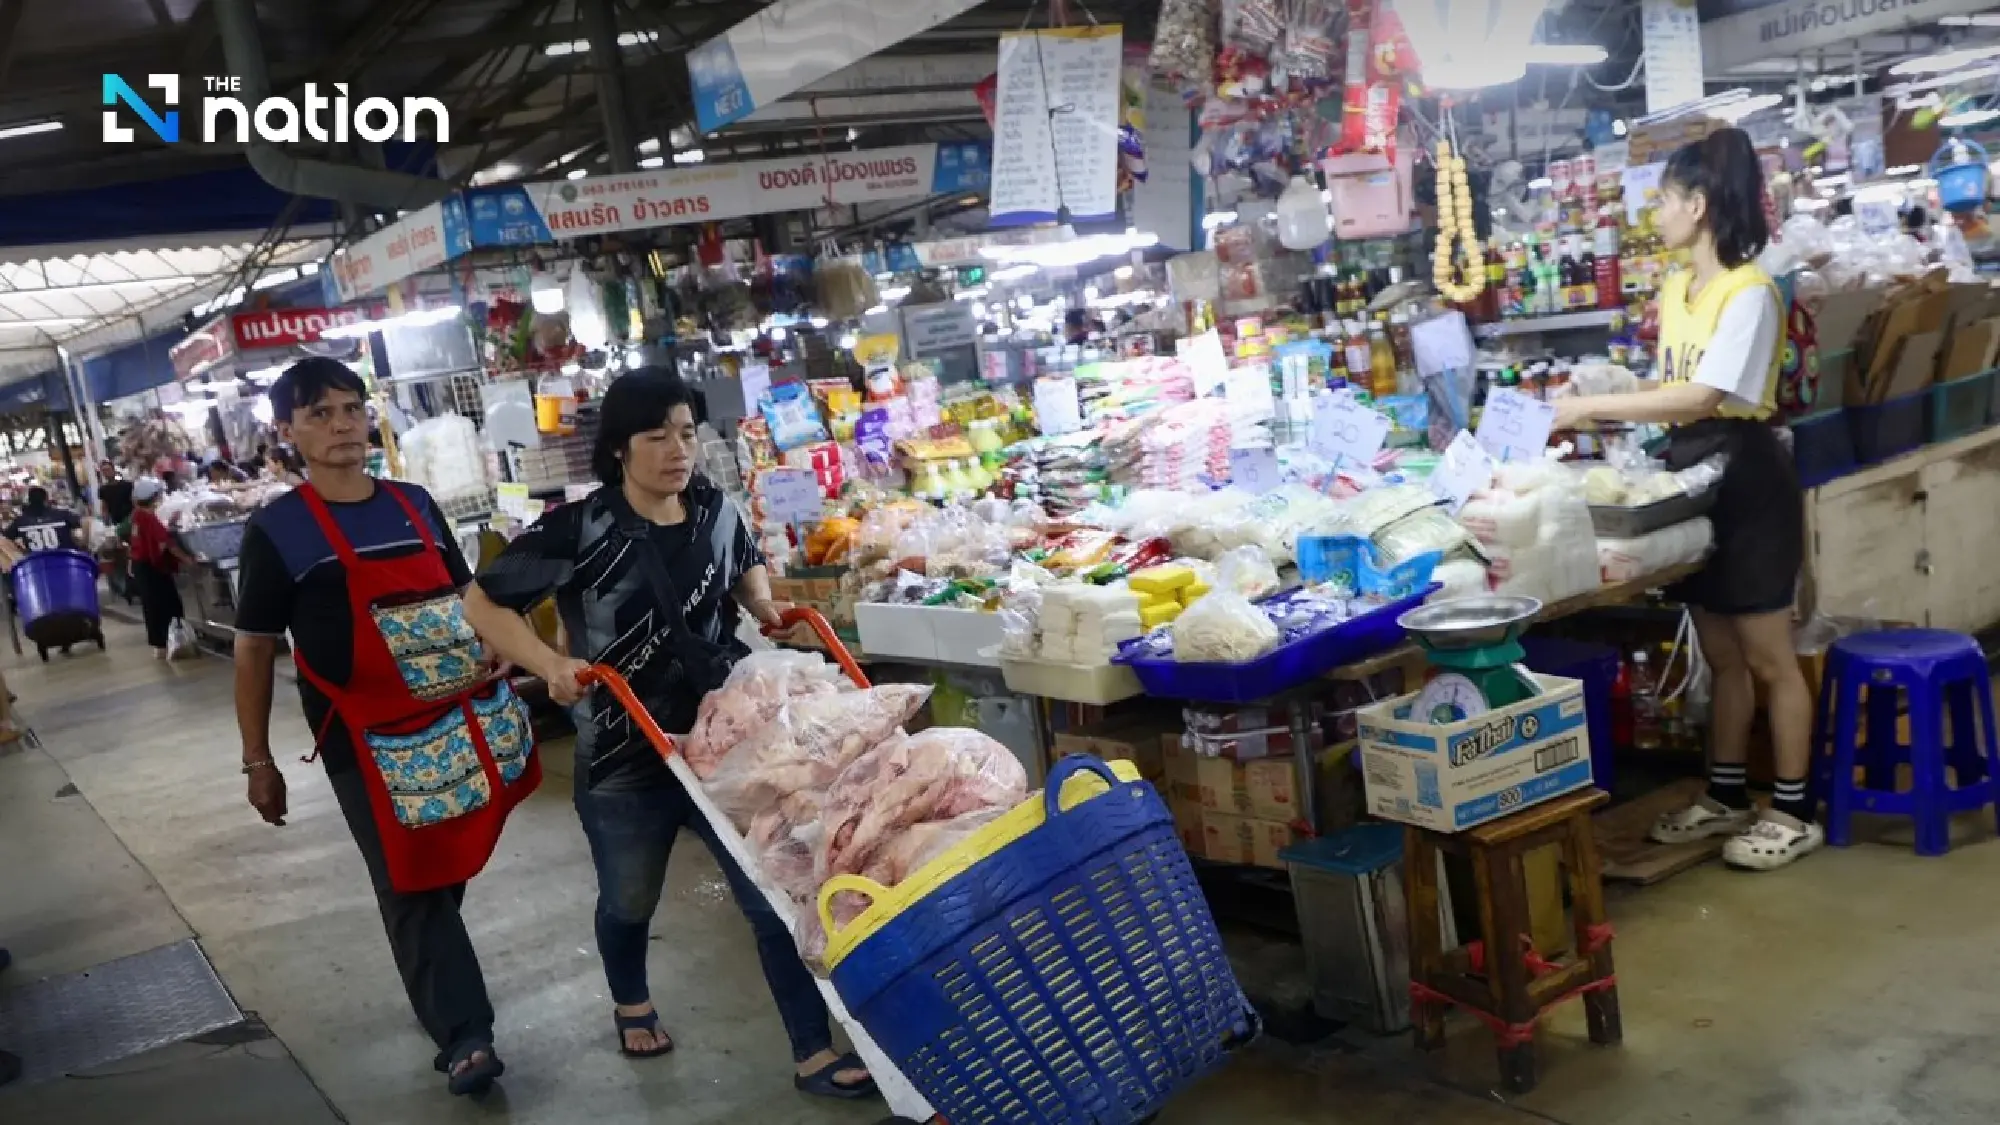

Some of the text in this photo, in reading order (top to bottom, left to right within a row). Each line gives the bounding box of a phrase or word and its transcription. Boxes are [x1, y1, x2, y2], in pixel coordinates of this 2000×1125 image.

[759, 162, 817, 189] ของดี
[549, 196, 711, 229] แสนรัก ข้าวสาร
[26, 527, 59, 551] 30
